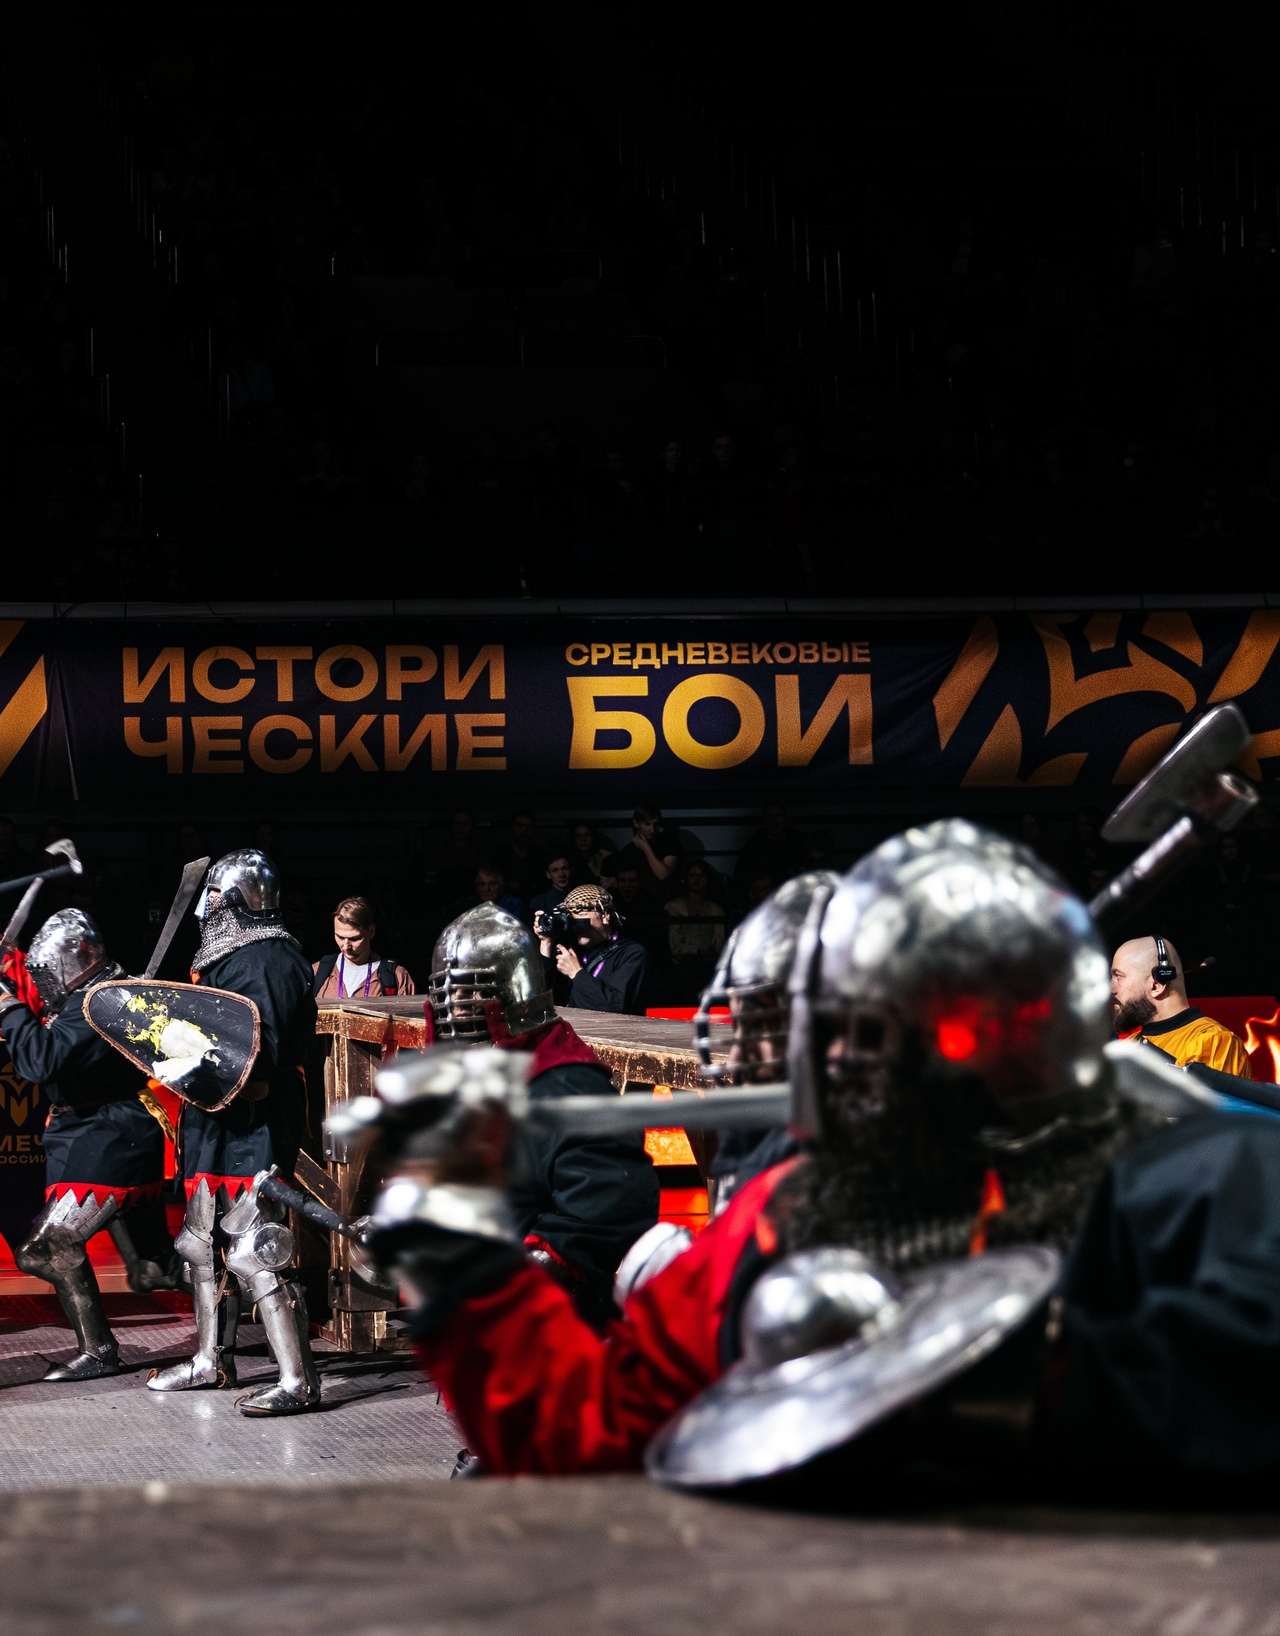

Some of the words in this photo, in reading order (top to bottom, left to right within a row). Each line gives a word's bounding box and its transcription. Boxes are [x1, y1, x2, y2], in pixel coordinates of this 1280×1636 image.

[123, 645, 505, 703] ИСТОРИ
[565, 641, 871, 669] СРЕДНЕВЕКОВЫЕ
[123, 713, 506, 773] ЧЕСКИЕ
[566, 673, 873, 769] БОИ
